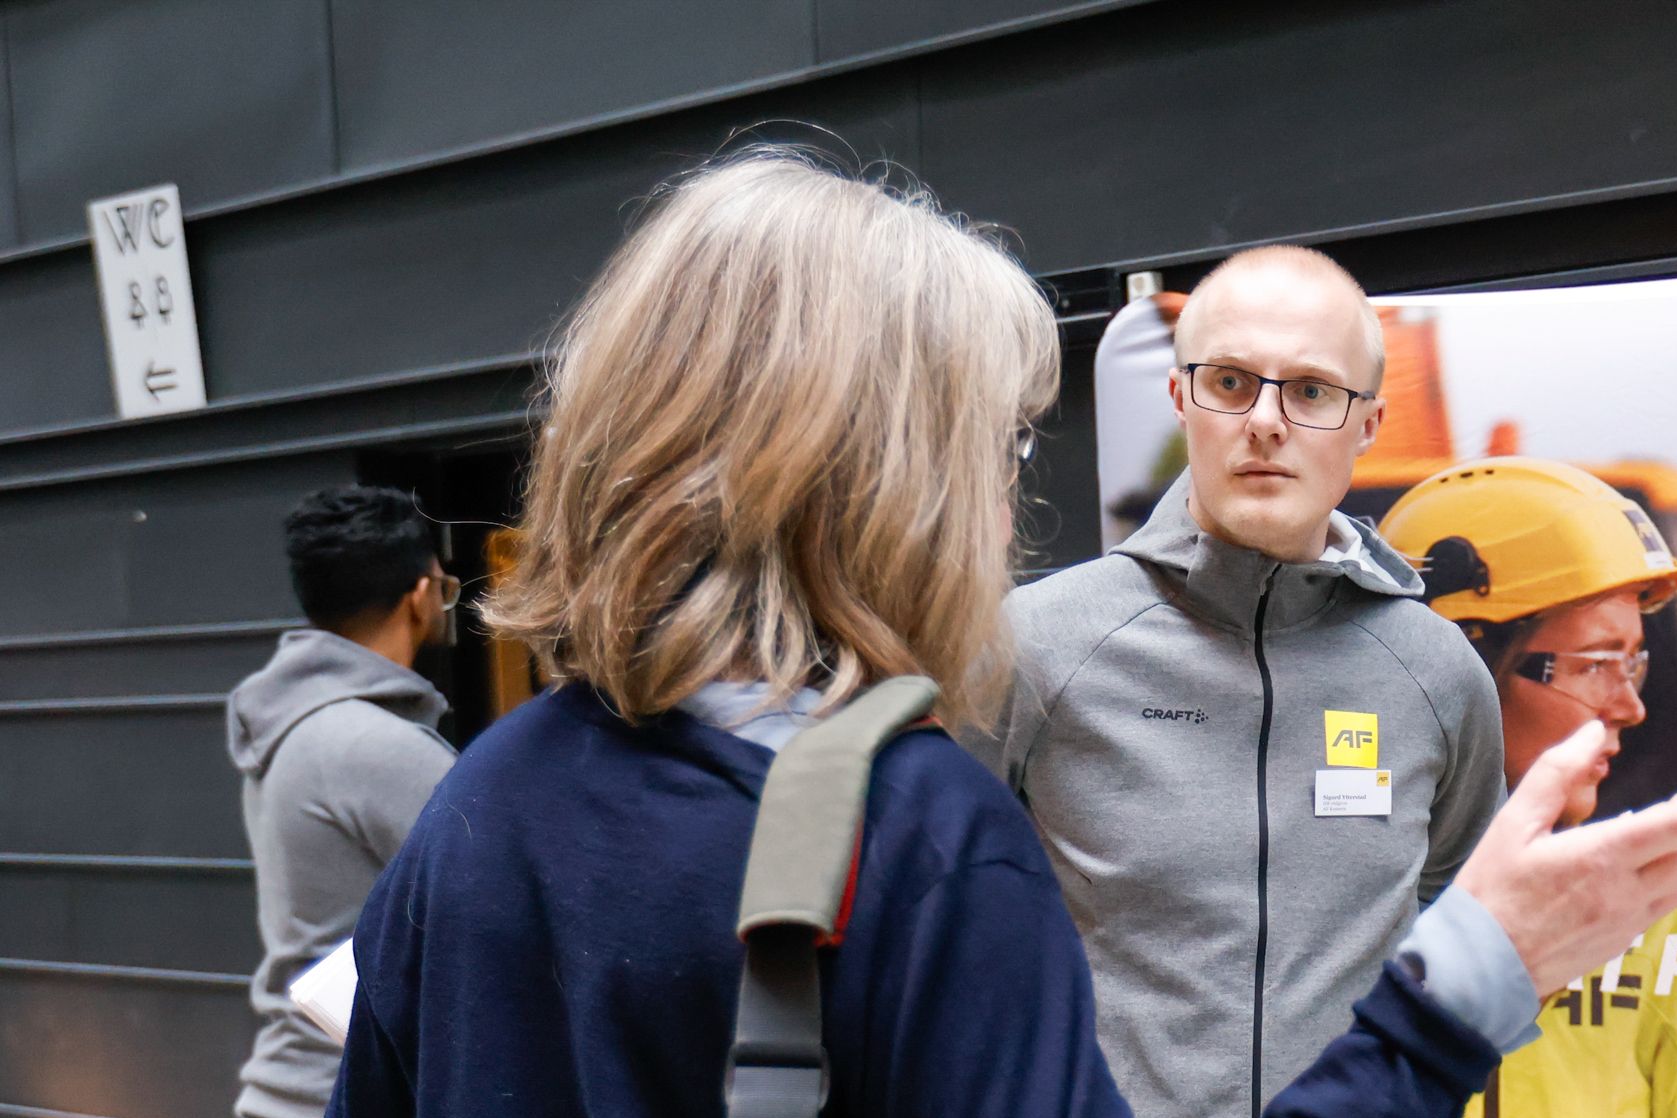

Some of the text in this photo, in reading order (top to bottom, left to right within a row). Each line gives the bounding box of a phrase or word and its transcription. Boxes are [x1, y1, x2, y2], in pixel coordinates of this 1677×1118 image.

[103, 198, 175, 255] WC
[1142, 707, 1194, 722] CRAFT
[1332, 729, 1373, 749] AF
